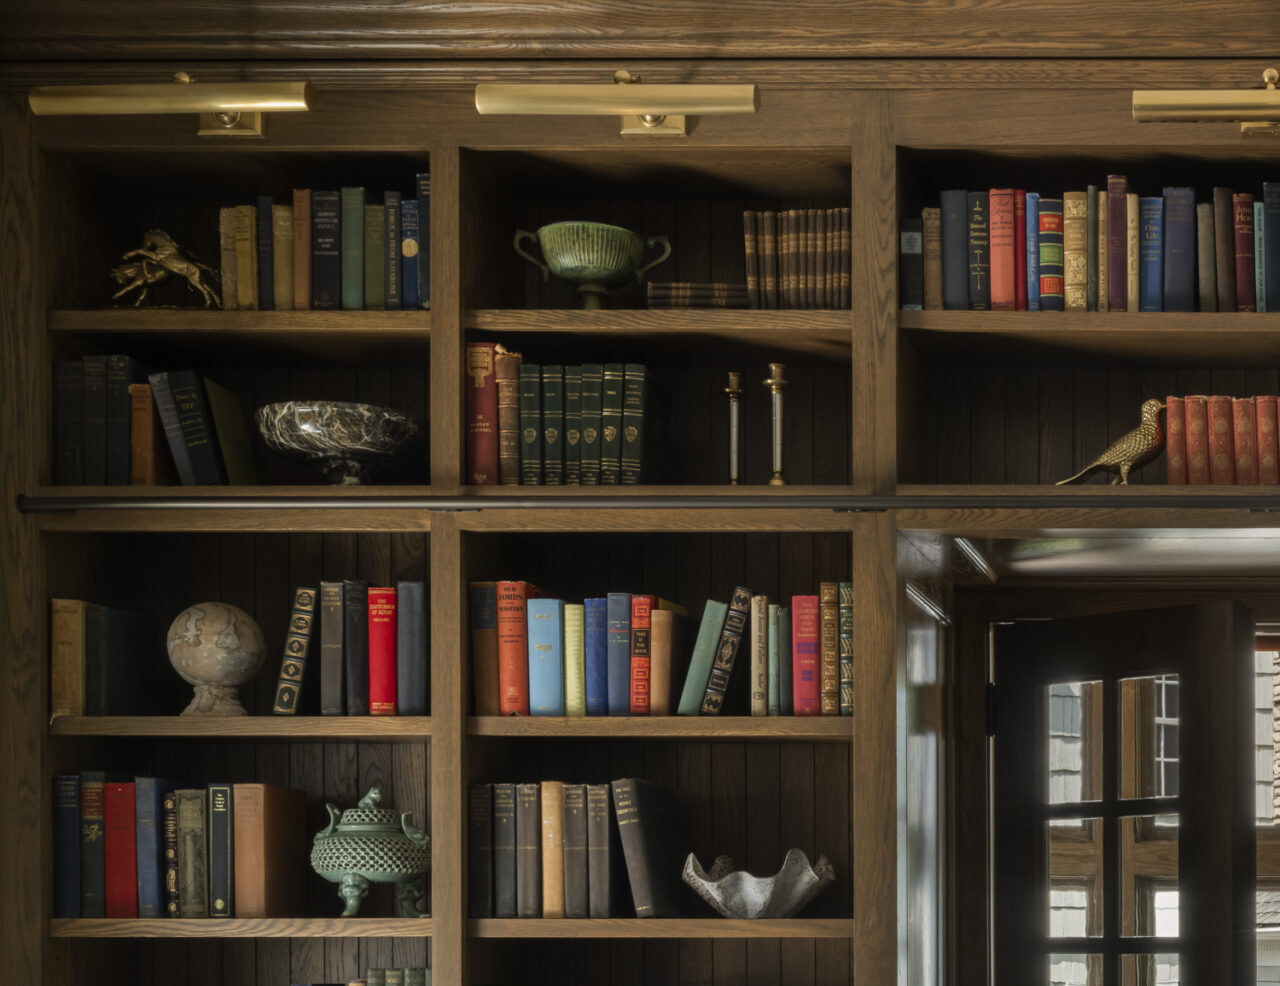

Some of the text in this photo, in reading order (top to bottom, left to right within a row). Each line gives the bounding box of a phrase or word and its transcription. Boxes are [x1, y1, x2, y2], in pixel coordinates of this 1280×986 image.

[1144, 224, 1158, 232] One
[1145, 232, 1158, 240] Life
[388, 239, 396, 258] FROM
[388, 259, 397, 296] NAVARONE
[499, 593, 523, 601] LORDS
